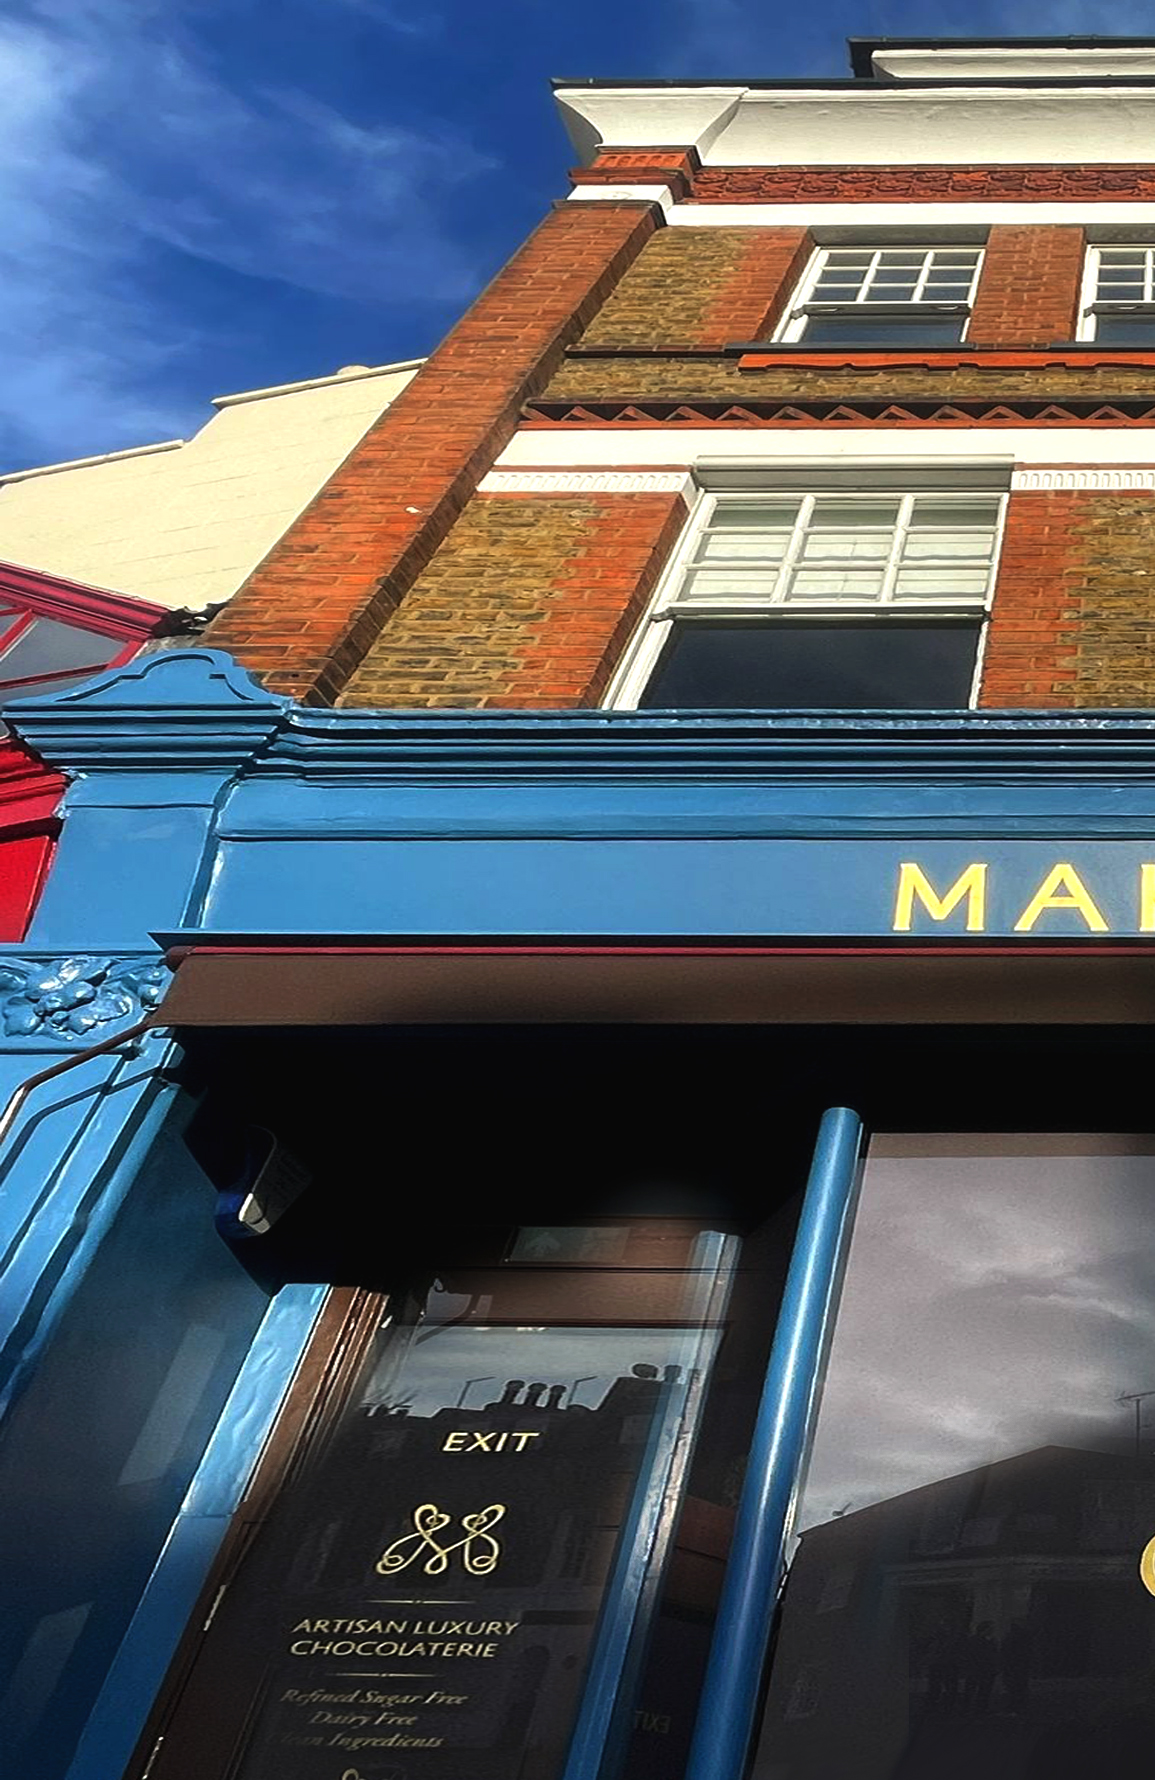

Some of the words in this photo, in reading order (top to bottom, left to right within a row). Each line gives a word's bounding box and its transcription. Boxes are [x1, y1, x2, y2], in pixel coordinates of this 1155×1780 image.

[441, 1431, 541, 1453] EXIT
[291, 1617, 407, 1635] ARTISAN
[412, 1619, 521, 1637] LUXURY
[289, 1639, 500, 1658] CHOCOLATERIE
[280, 1688, 361, 1706] Refined
[358, 1689, 424, 1708] Sugar
[424, 1690, 469, 1705] Free
[308, 1710, 368, 1730] Dairy
[372, 1711, 419, 1727] Free
[327, 1732, 445, 1751] Ingredients
